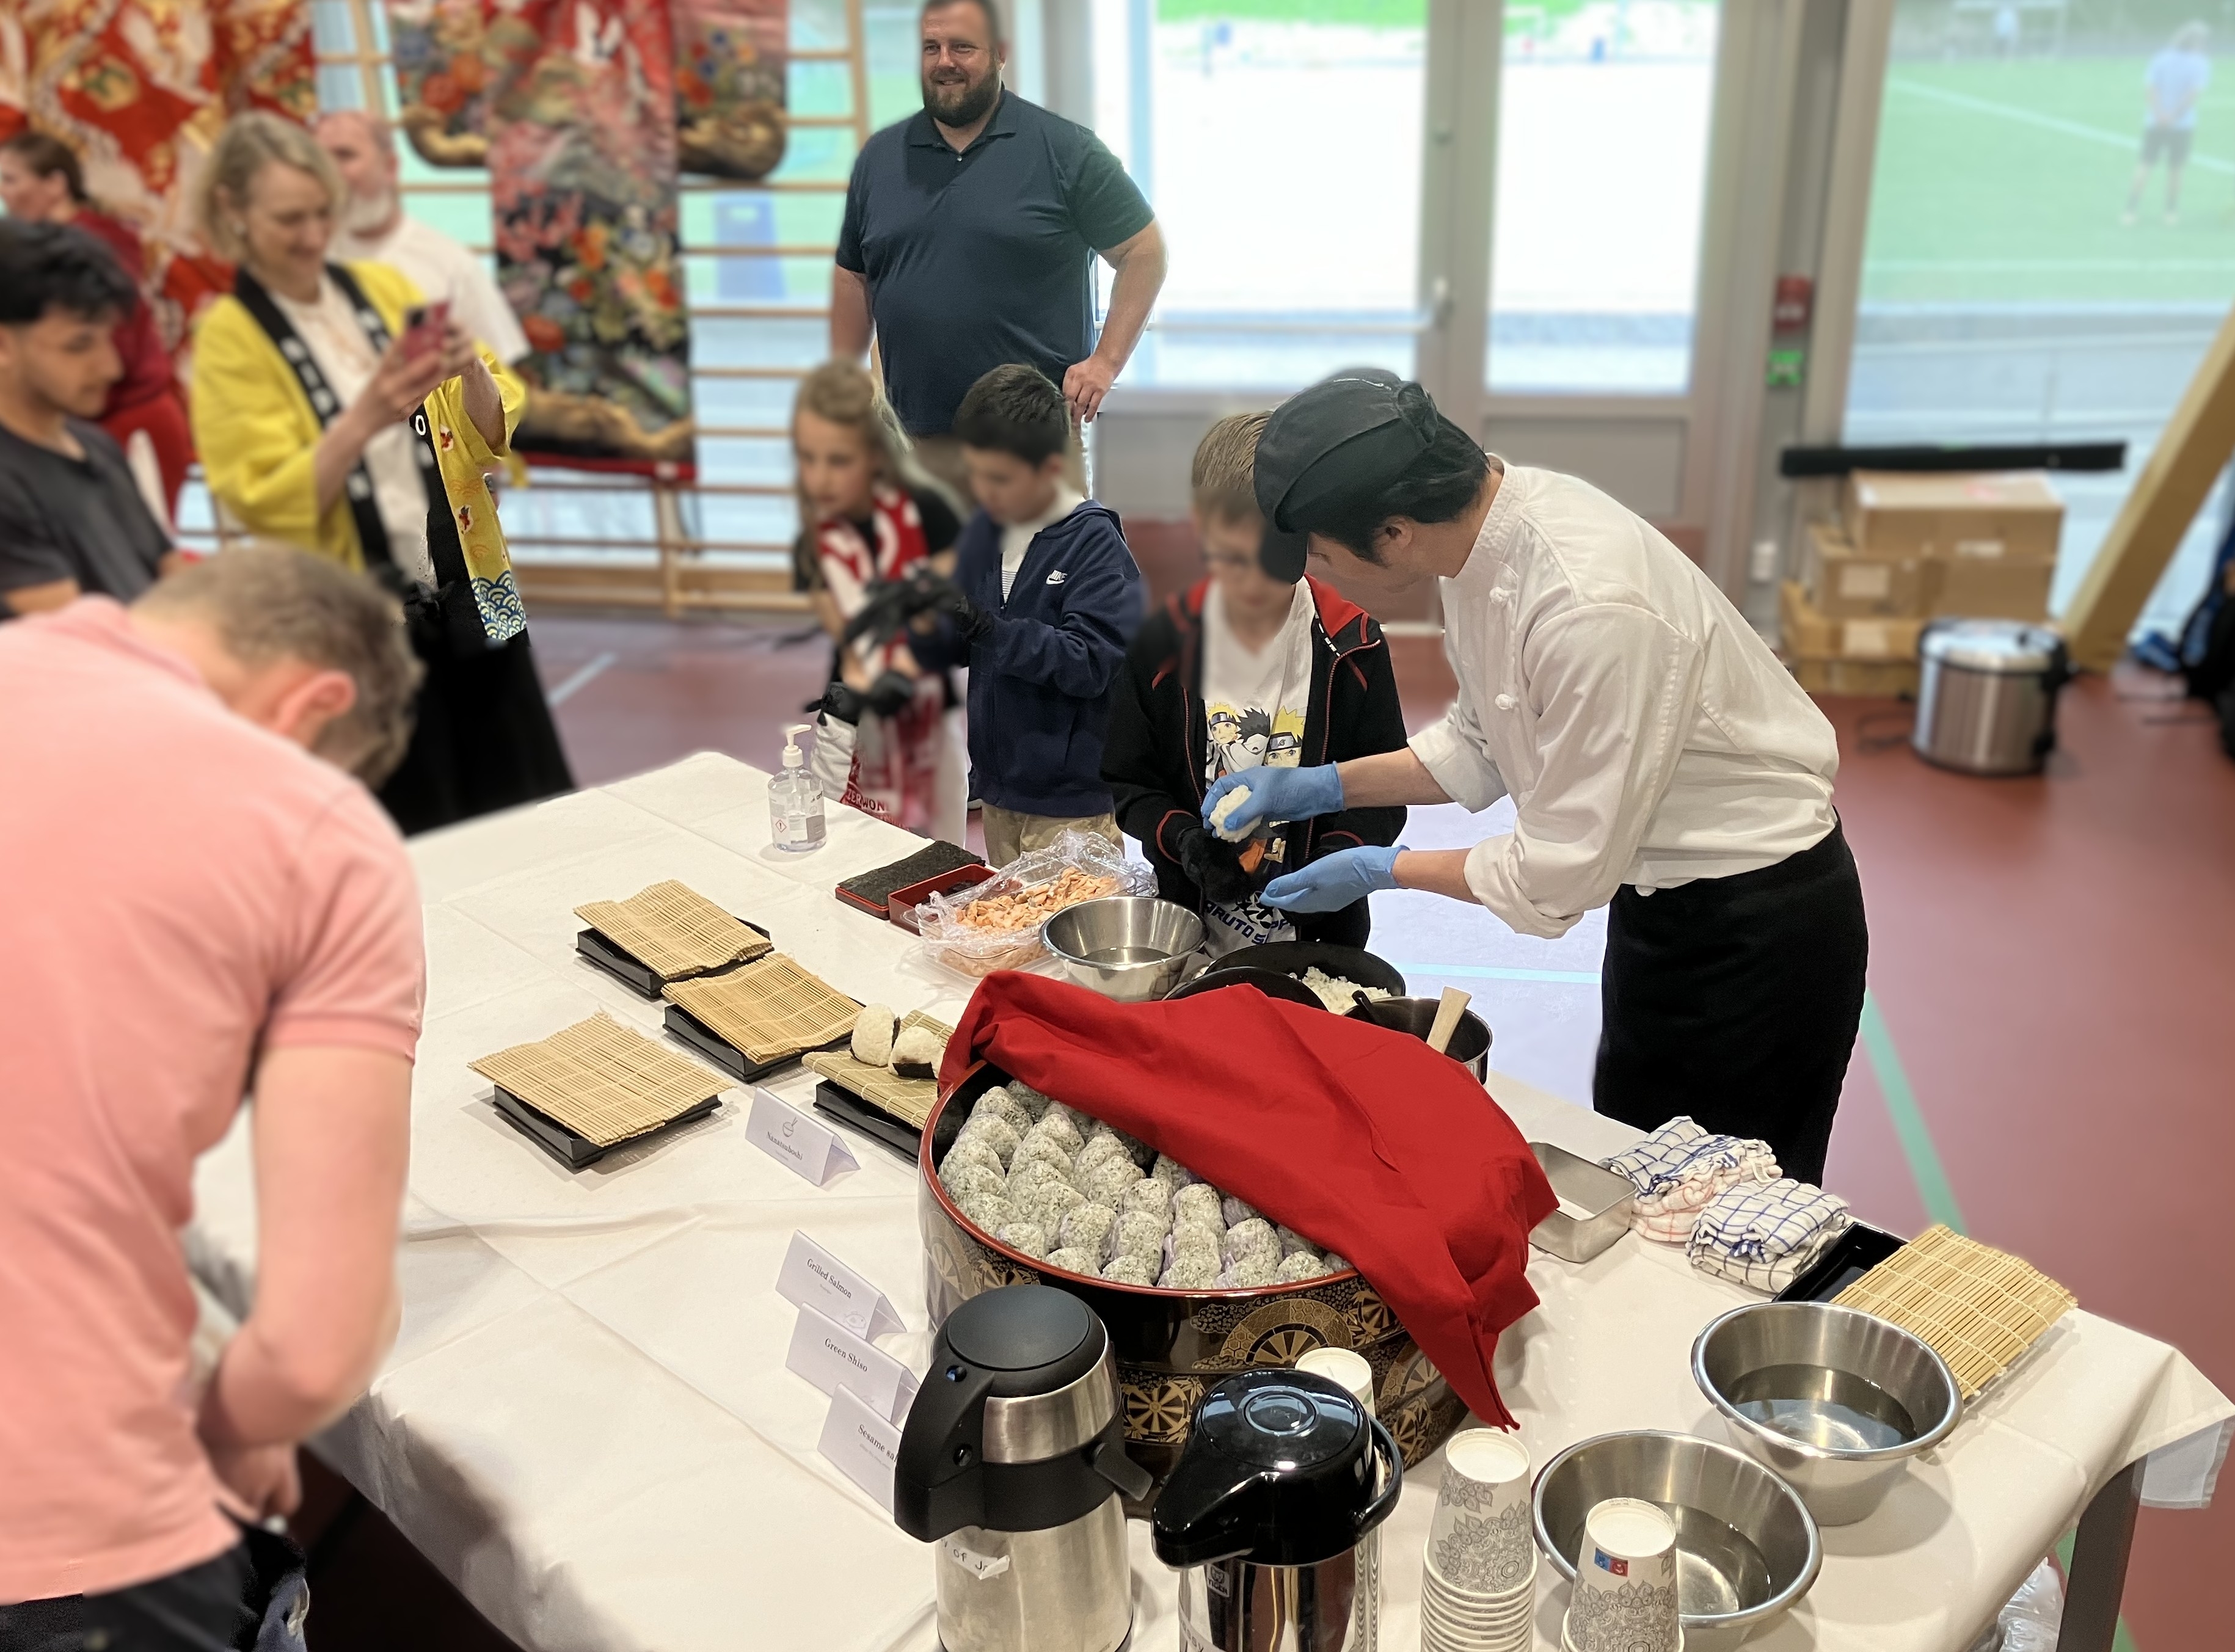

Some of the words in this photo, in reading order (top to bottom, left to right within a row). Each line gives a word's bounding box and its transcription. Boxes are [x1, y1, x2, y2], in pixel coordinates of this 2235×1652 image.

[807, 1258, 829, 1281] Grilled
[829, 1275, 852, 1298] Salmon
[825, 1337, 846, 1358] Green
[847, 1352, 868, 1372] Shiso
[858, 1424, 885, 1452] Sesame
